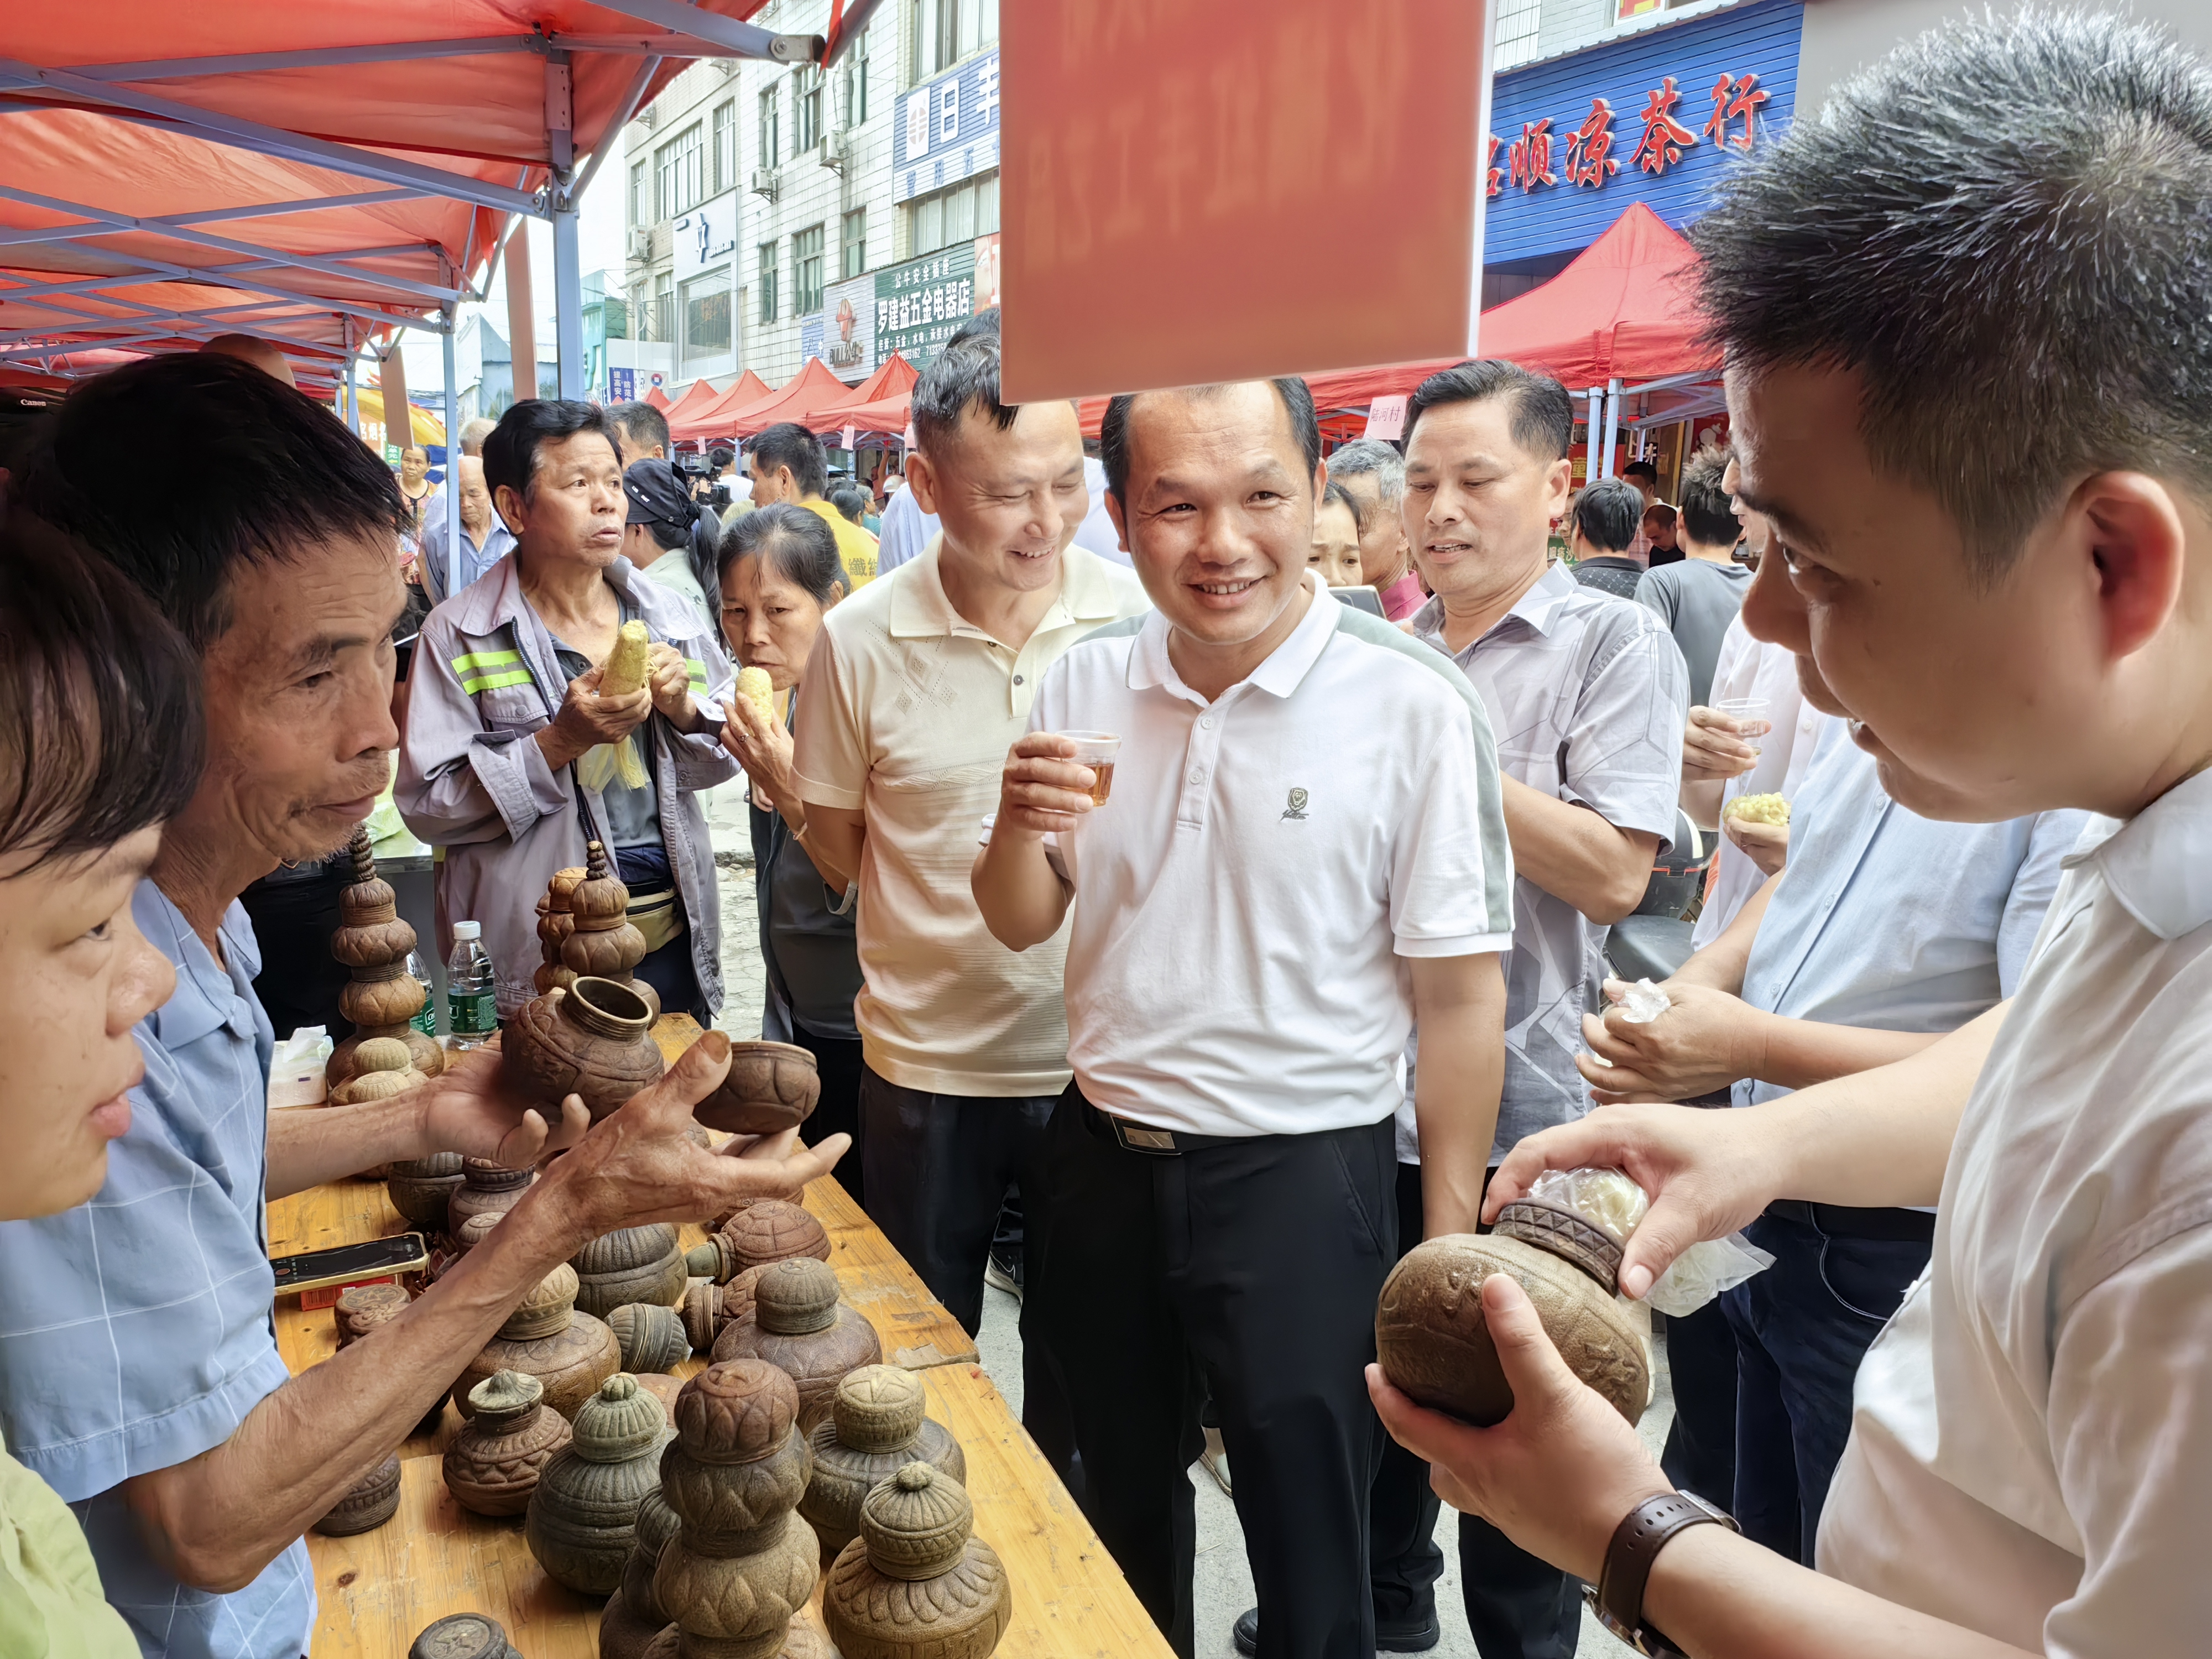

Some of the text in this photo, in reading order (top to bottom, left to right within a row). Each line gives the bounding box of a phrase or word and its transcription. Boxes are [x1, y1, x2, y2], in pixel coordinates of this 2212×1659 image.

[895, 258, 950, 289] 公牛安全插座
[878, 278, 971, 335] 罗建益五金电器店
